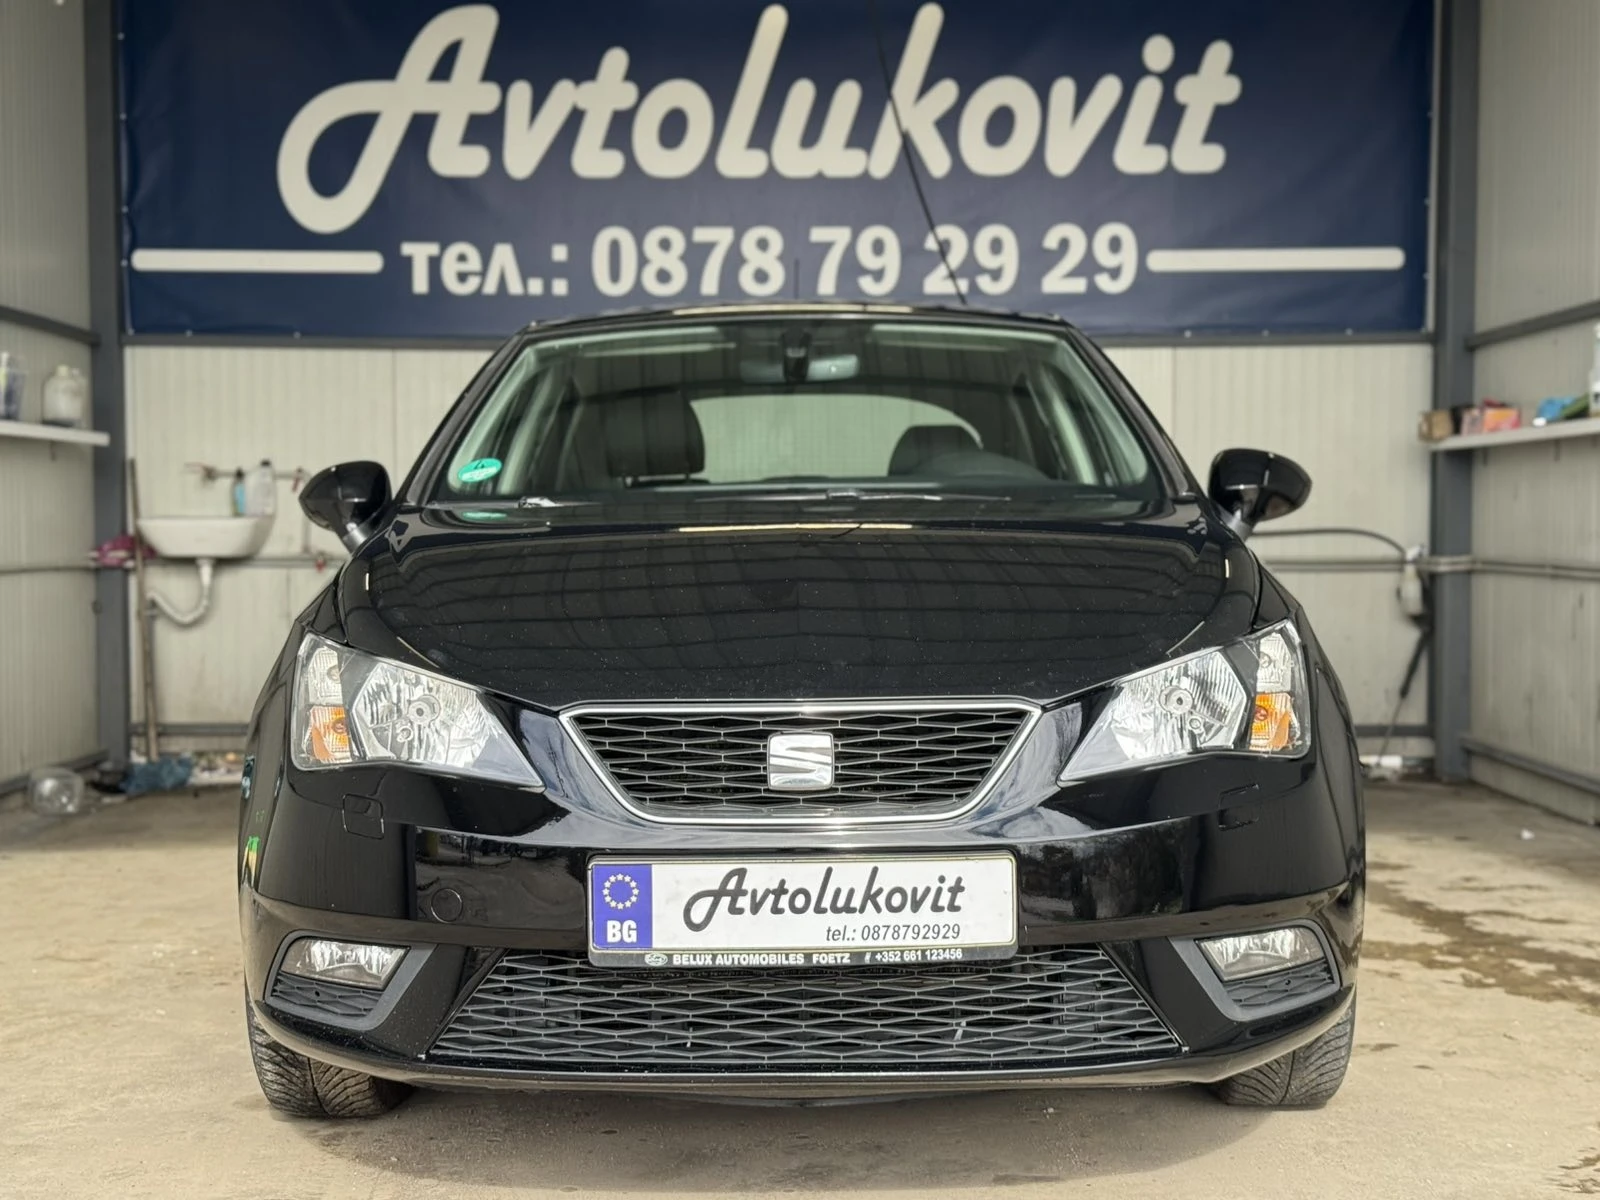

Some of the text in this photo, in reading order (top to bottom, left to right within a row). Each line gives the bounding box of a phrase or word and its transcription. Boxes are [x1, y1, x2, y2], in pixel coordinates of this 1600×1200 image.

[278, 4, 1241, 234] Avtolukovit
[400, 222, 1139, 298] тел.: 0878 79 29 29
[683, 866, 966, 931] Avtolukovit
[606, 920, 637, 943] BG
[826, 923, 961, 942] tel.: 0878792929
[672, 954, 713, 965] BELUX
[716, 954, 804, 965] AUTOMOBILES
[813, 953, 850, 964] FOETZ
[875, 951, 901, 962] +352
[904, 950, 922, 960] 661
[925, 949, 963, 960] 123456
